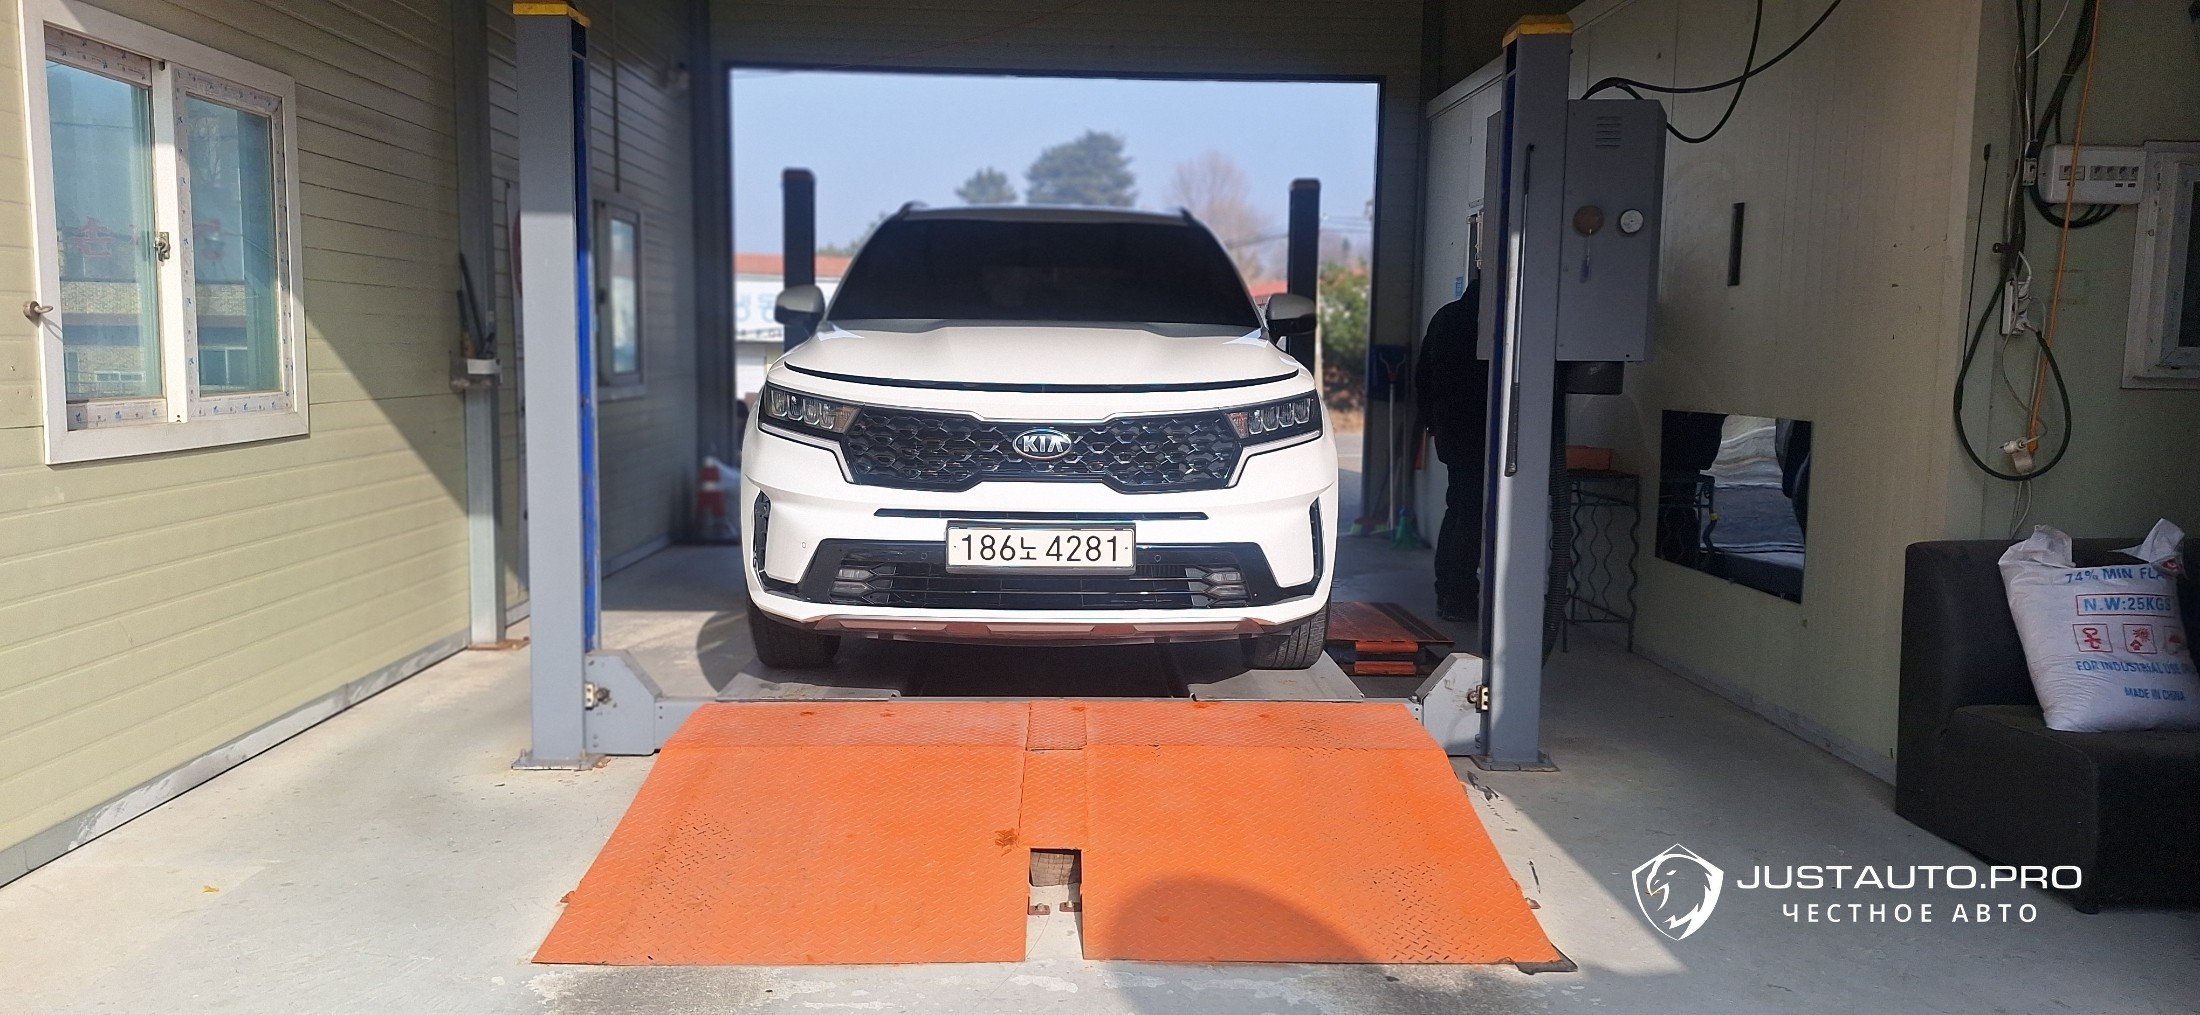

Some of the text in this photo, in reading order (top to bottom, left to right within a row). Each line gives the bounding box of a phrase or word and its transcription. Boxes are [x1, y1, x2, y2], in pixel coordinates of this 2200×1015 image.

[1022, 434, 1064, 453] KIA
[961, 533, 1117, 562] 186노 4281
[2065, 570, 2099, 583] 74%
[2102, 568, 2133, 580] MIN
[2076, 660, 2099, 671] FOR
[2101, 661, 2164, 673] INDUSTRIAL
[2124, 687, 2186, 700] MADE IN CHINA
